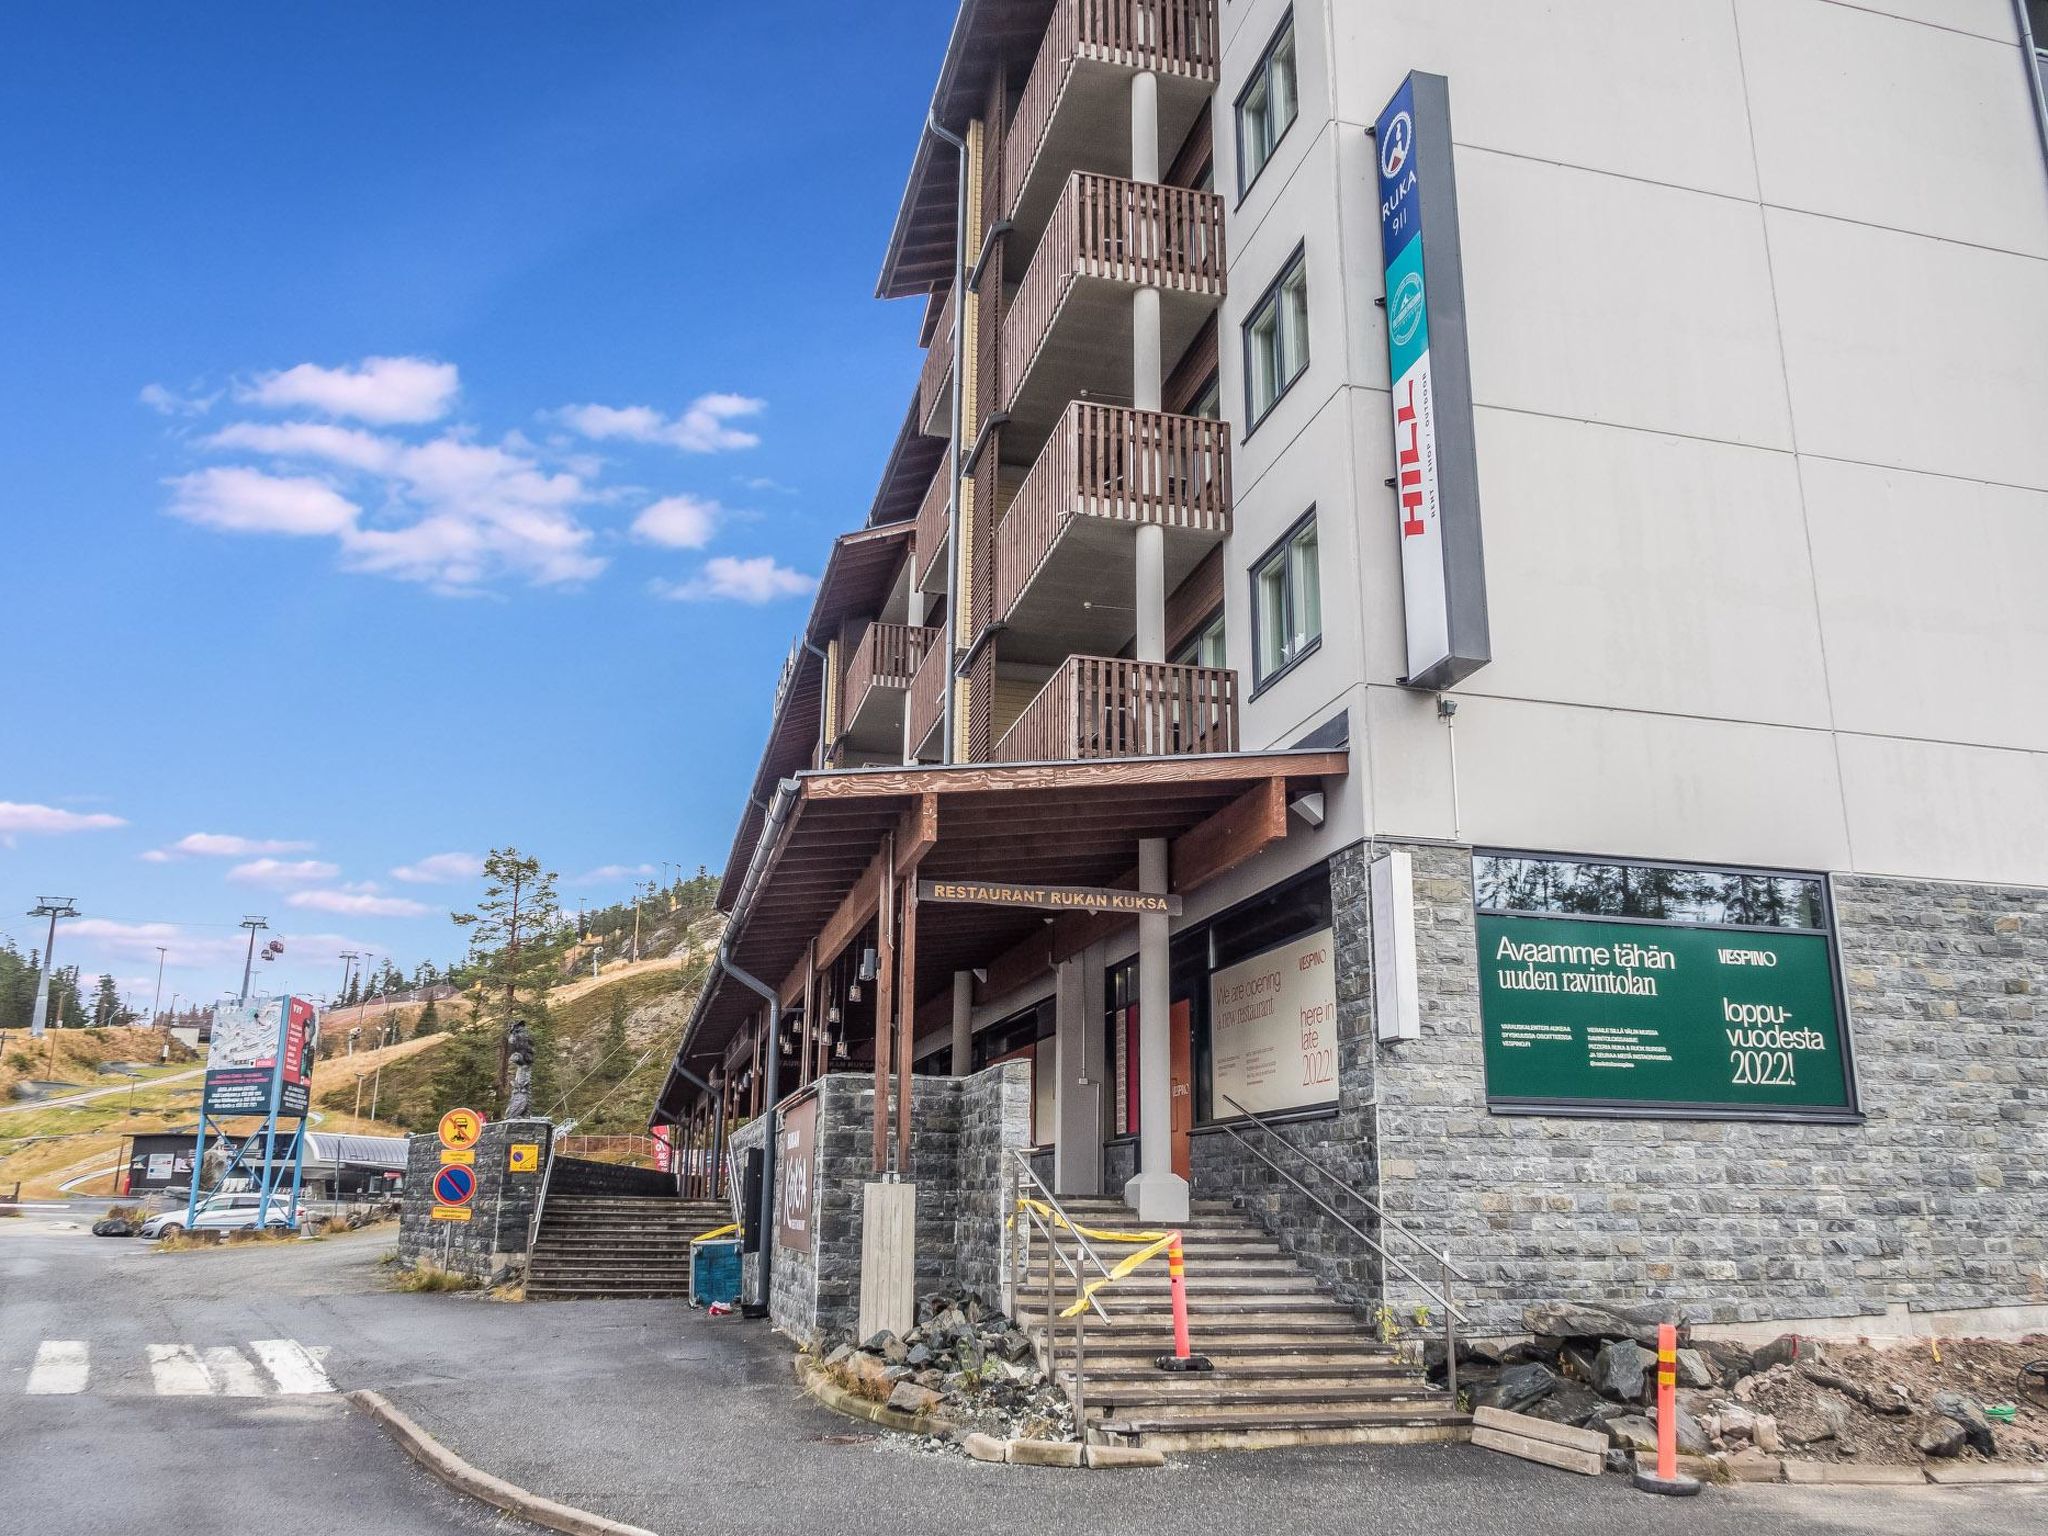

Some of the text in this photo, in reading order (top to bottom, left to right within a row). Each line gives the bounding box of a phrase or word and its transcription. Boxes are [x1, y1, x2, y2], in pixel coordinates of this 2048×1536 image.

[1383, 170, 1416, 221] RUKA
[1398, 380, 1424, 540] HILL
[934, 884, 1168, 910] RESTAURANT RUKAN KUKSA
[1496, 936, 1676, 970] Avaamme tähän
[1718, 949, 1776, 967] VESPINO
[1246, 970, 1280, 998] opening
[1498, 963, 1658, 996] uuden ravintolan
[1237, 996, 1274, 1024] restaurant
[1300, 998, 1334, 1027] here in
[1723, 996, 1792, 1028] loppu-
[1301, 1028, 1318, 1050] late
[1726, 1024, 1826, 1050] vuodesta
[1302, 1048, 1334, 1086] 2022!
[1730, 1050, 1796, 1086] 2022!
